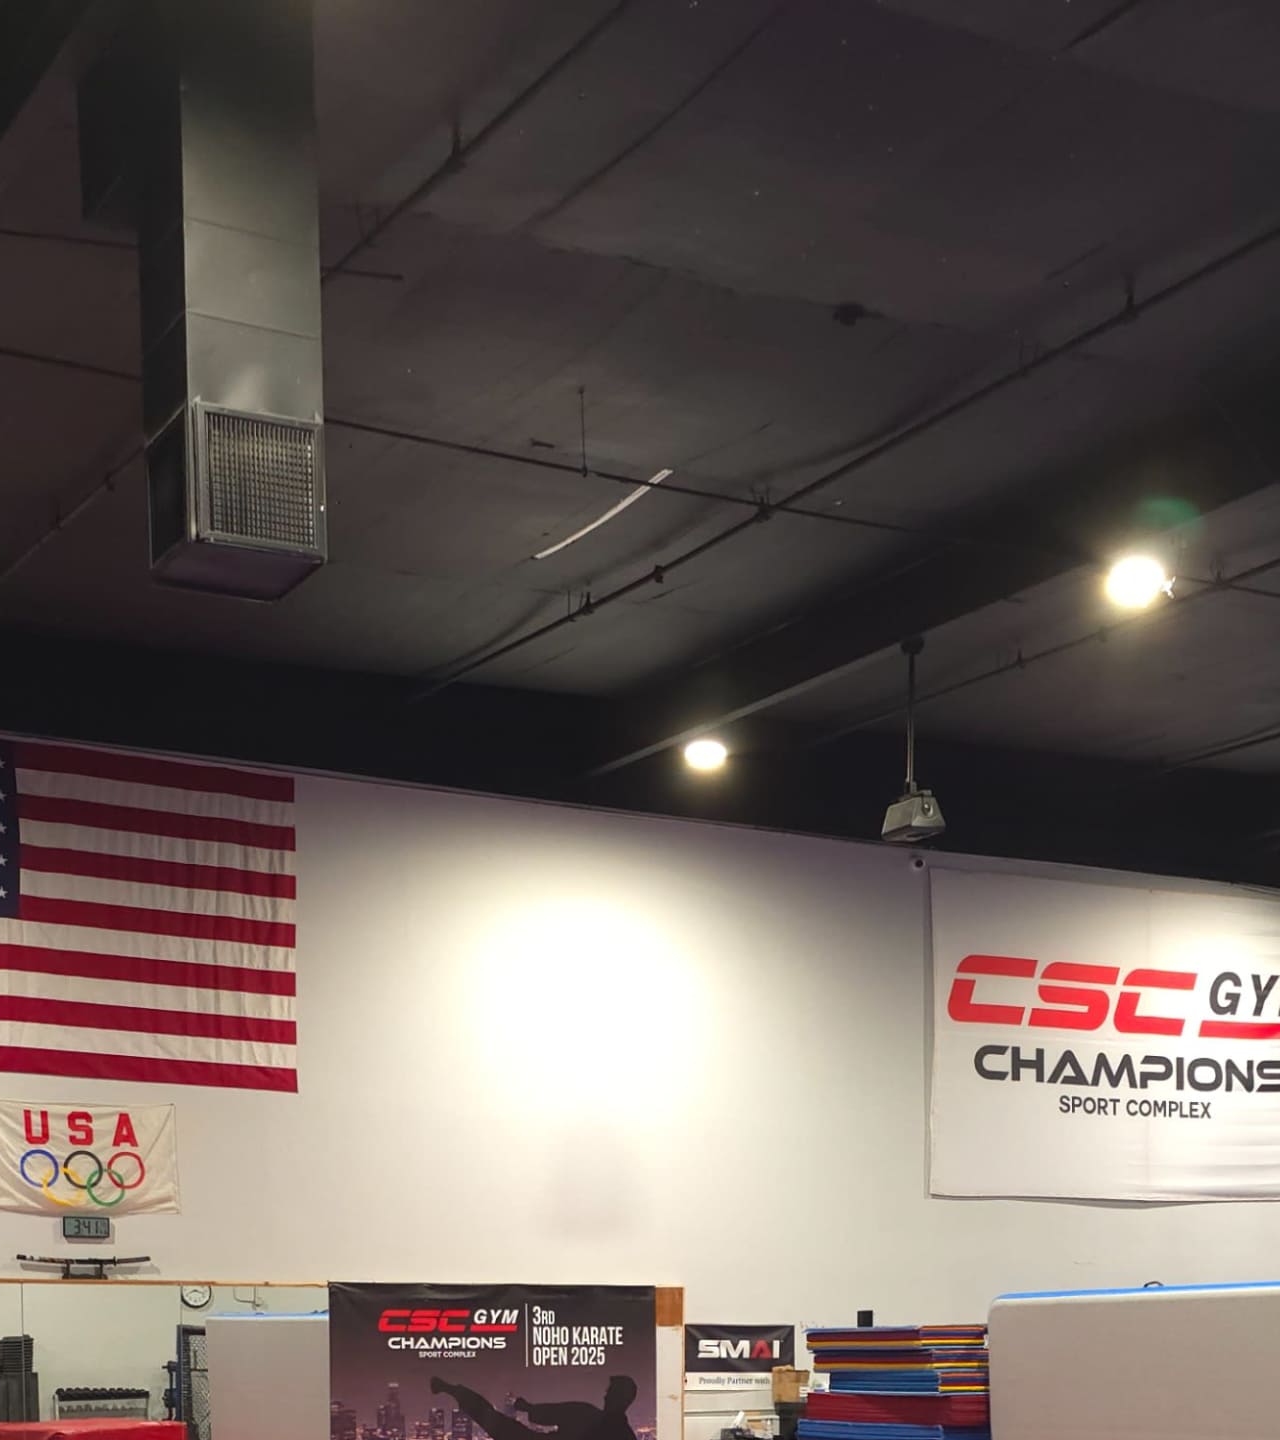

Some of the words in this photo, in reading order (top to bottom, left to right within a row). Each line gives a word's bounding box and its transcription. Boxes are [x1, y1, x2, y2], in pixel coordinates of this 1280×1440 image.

[947, 954, 1198, 1038] CSC
[1059, 1095, 1121, 1116] SPORT
[1125, 1099, 1212, 1120] COMPLEX
[378, 1309, 470, 1332] CSC
[474, 1309, 519, 1324] GYM
[532, 1306, 556, 1325] 3RD
[388, 1337, 507, 1349] CHAMPIONS
[533, 1326, 569, 1345] NOHO
[572, 1326, 624, 1345] KARATE
[533, 1346, 568, 1366] OPEN
[571, 1346, 605, 1366] 2025
[697, 1339, 781, 1359] SMAI
[699, 1377, 726, 1386] Proudly
[727, 1377, 753, 1385] Partner
